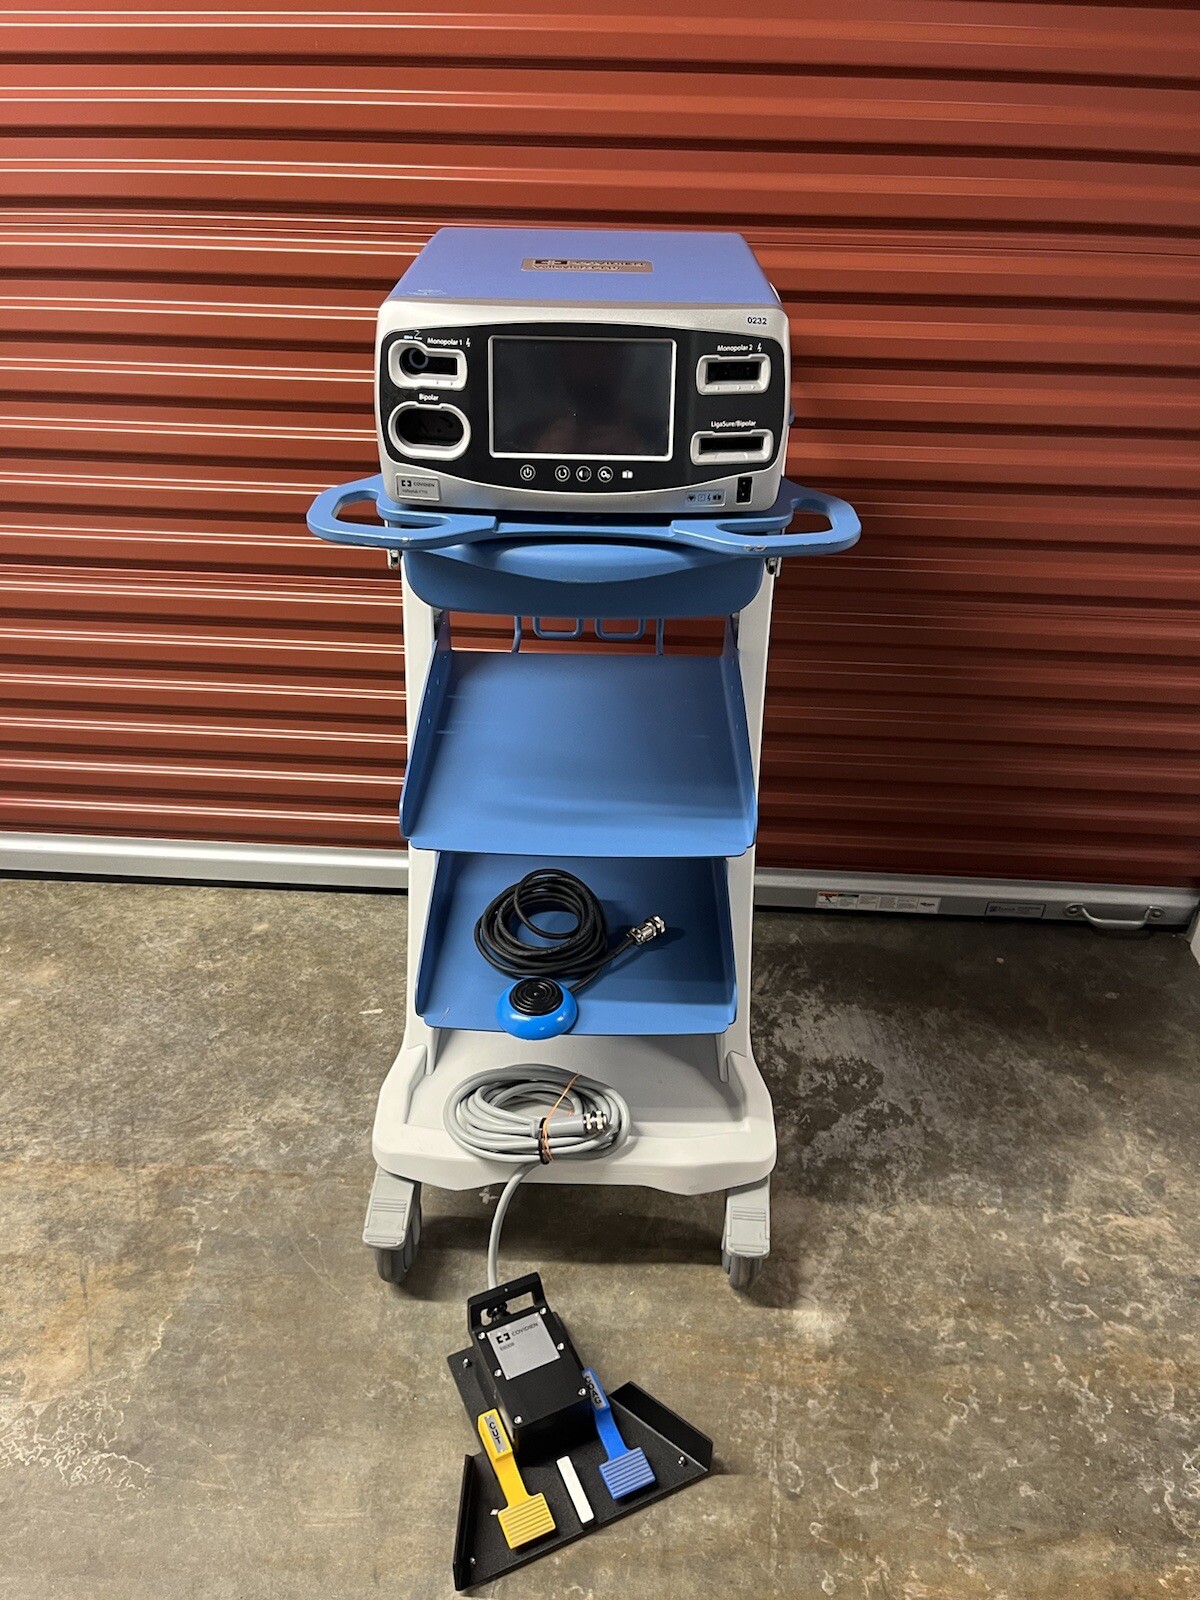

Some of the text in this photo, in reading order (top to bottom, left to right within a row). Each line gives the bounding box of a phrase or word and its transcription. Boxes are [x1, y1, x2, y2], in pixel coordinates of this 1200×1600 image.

[747, 316, 767, 325] 0232
[427, 337, 458, 347] Monopolar
[717, 344, 748, 352] Monopolar
[418, 393, 439, 401] Bipolar
[710, 420, 757, 428] LigaSure/Bipolar
[511, 1322, 539, 1336] COVIDIEN
[584, 1375, 602, 1404] COAG
[489, 1421, 501, 1444] CUT
